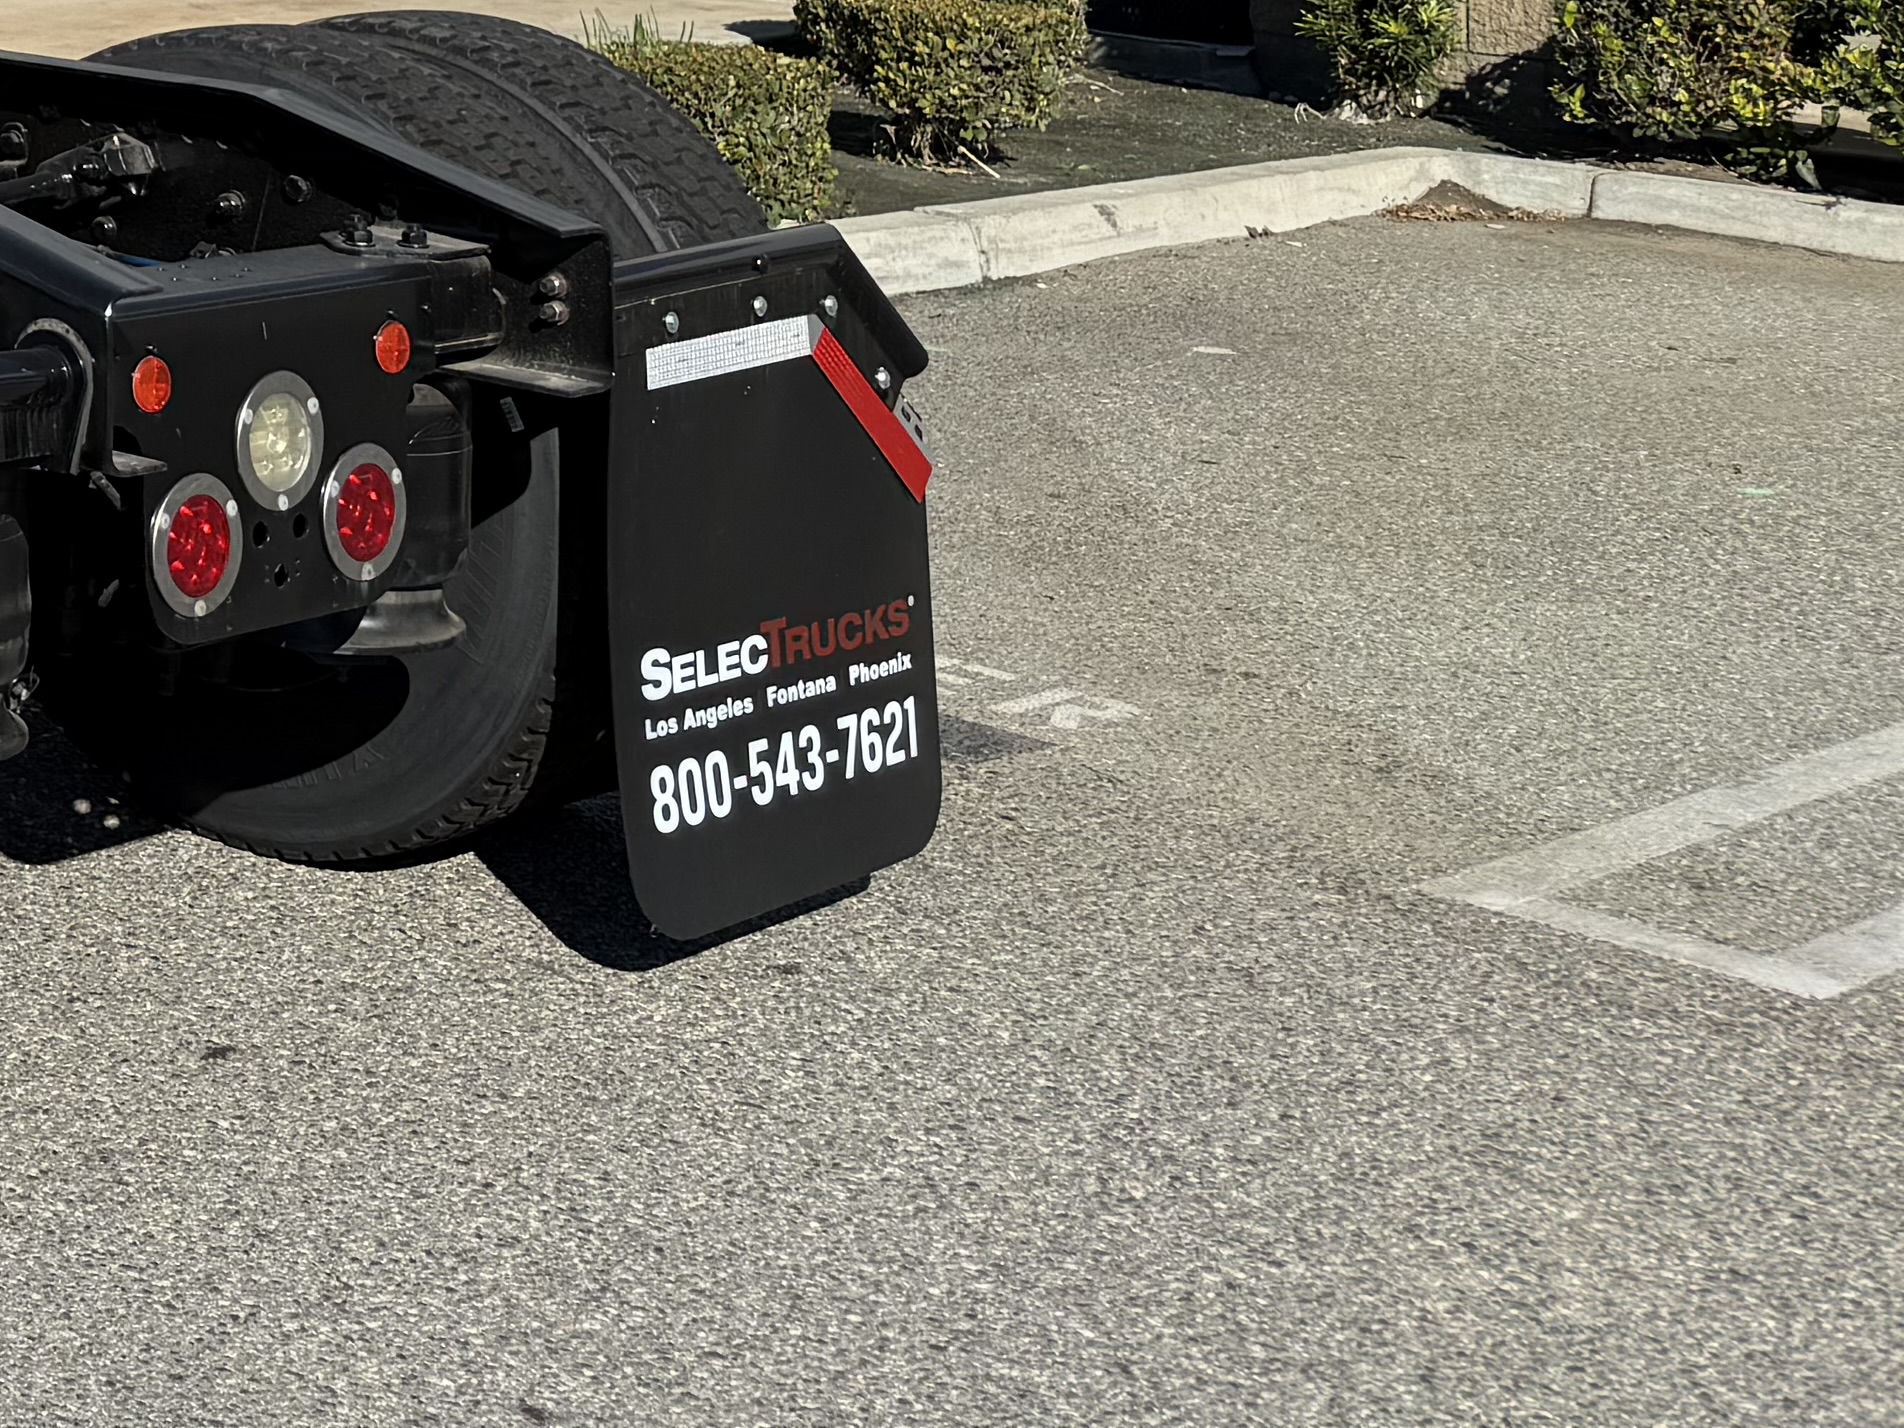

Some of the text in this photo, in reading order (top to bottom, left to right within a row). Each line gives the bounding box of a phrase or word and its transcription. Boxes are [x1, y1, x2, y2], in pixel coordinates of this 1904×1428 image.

[641, 597, 911, 702] SELECTRUCKS
[645, 651, 913, 741] Los Angeles Fontana Phoenix
[649, 695, 919, 834] 800-543-7621
